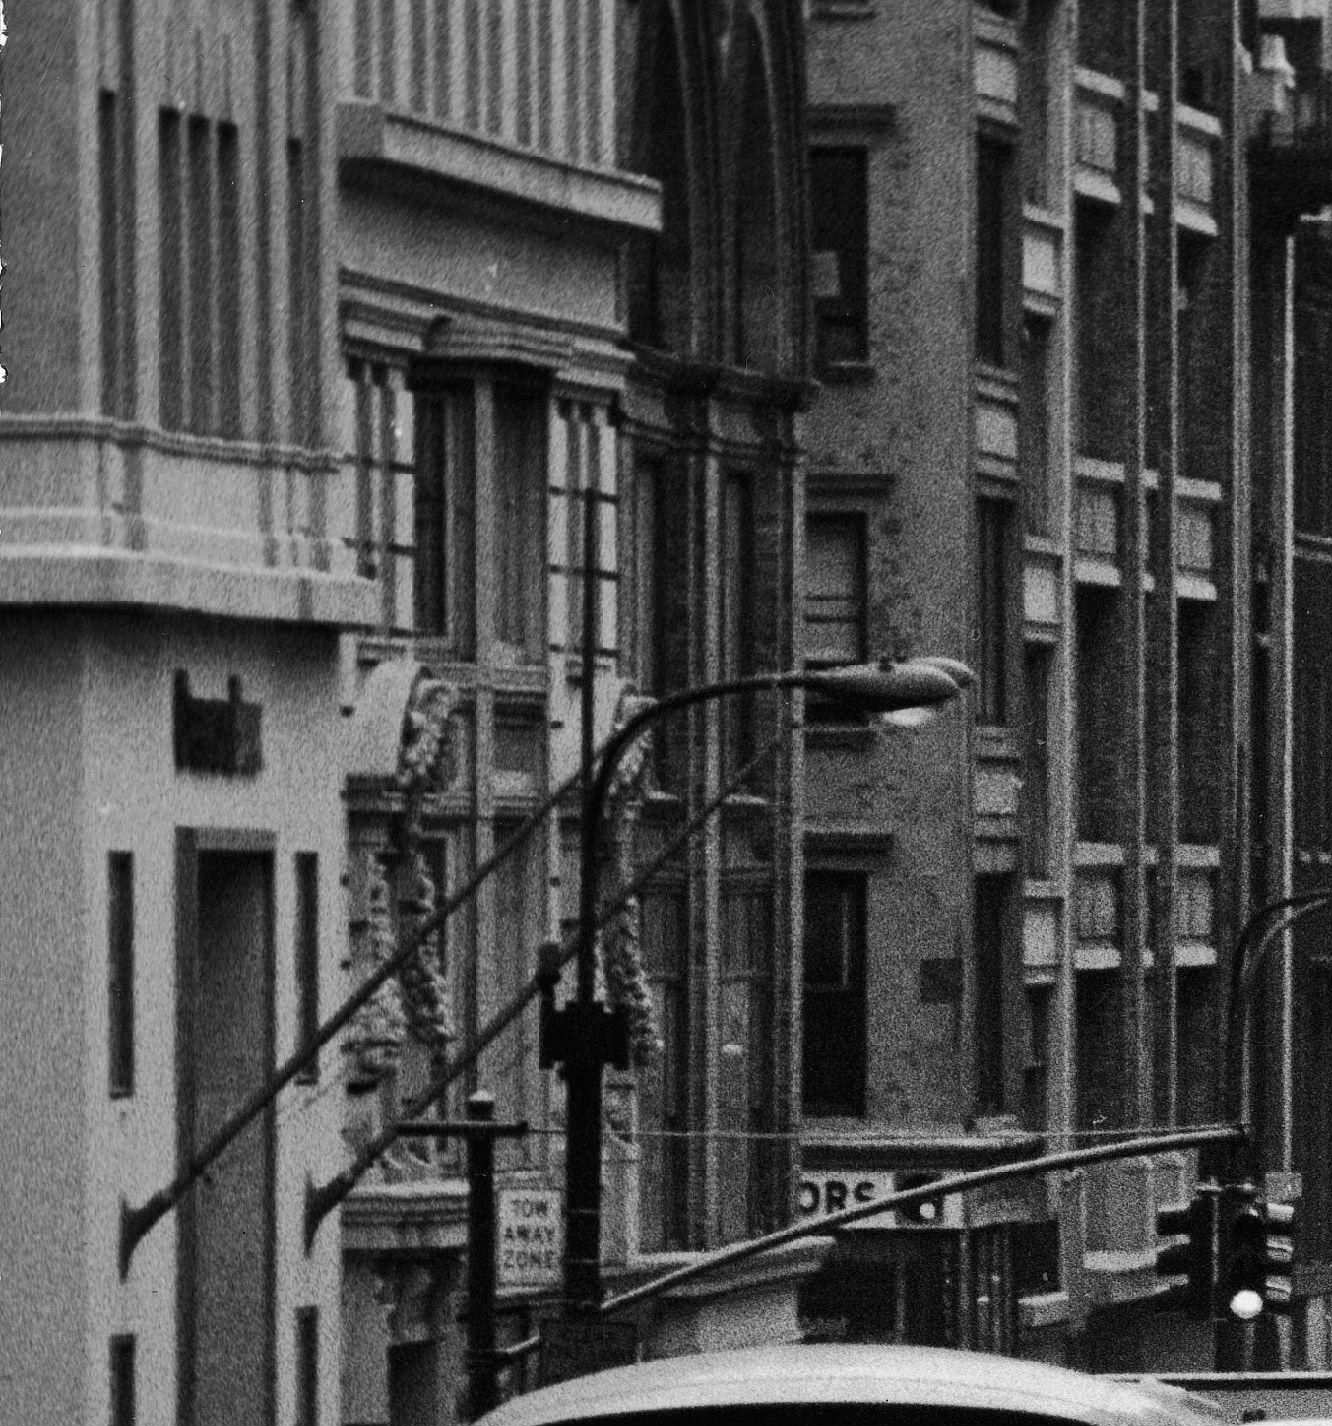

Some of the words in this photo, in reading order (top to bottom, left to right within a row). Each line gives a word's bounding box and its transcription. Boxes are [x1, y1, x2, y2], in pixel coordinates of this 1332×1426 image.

[511, 1199, 549, 1218] TOW
[503, 1226, 556, 1244] AWAY
[503, 1249, 557, 1270] ZONE
